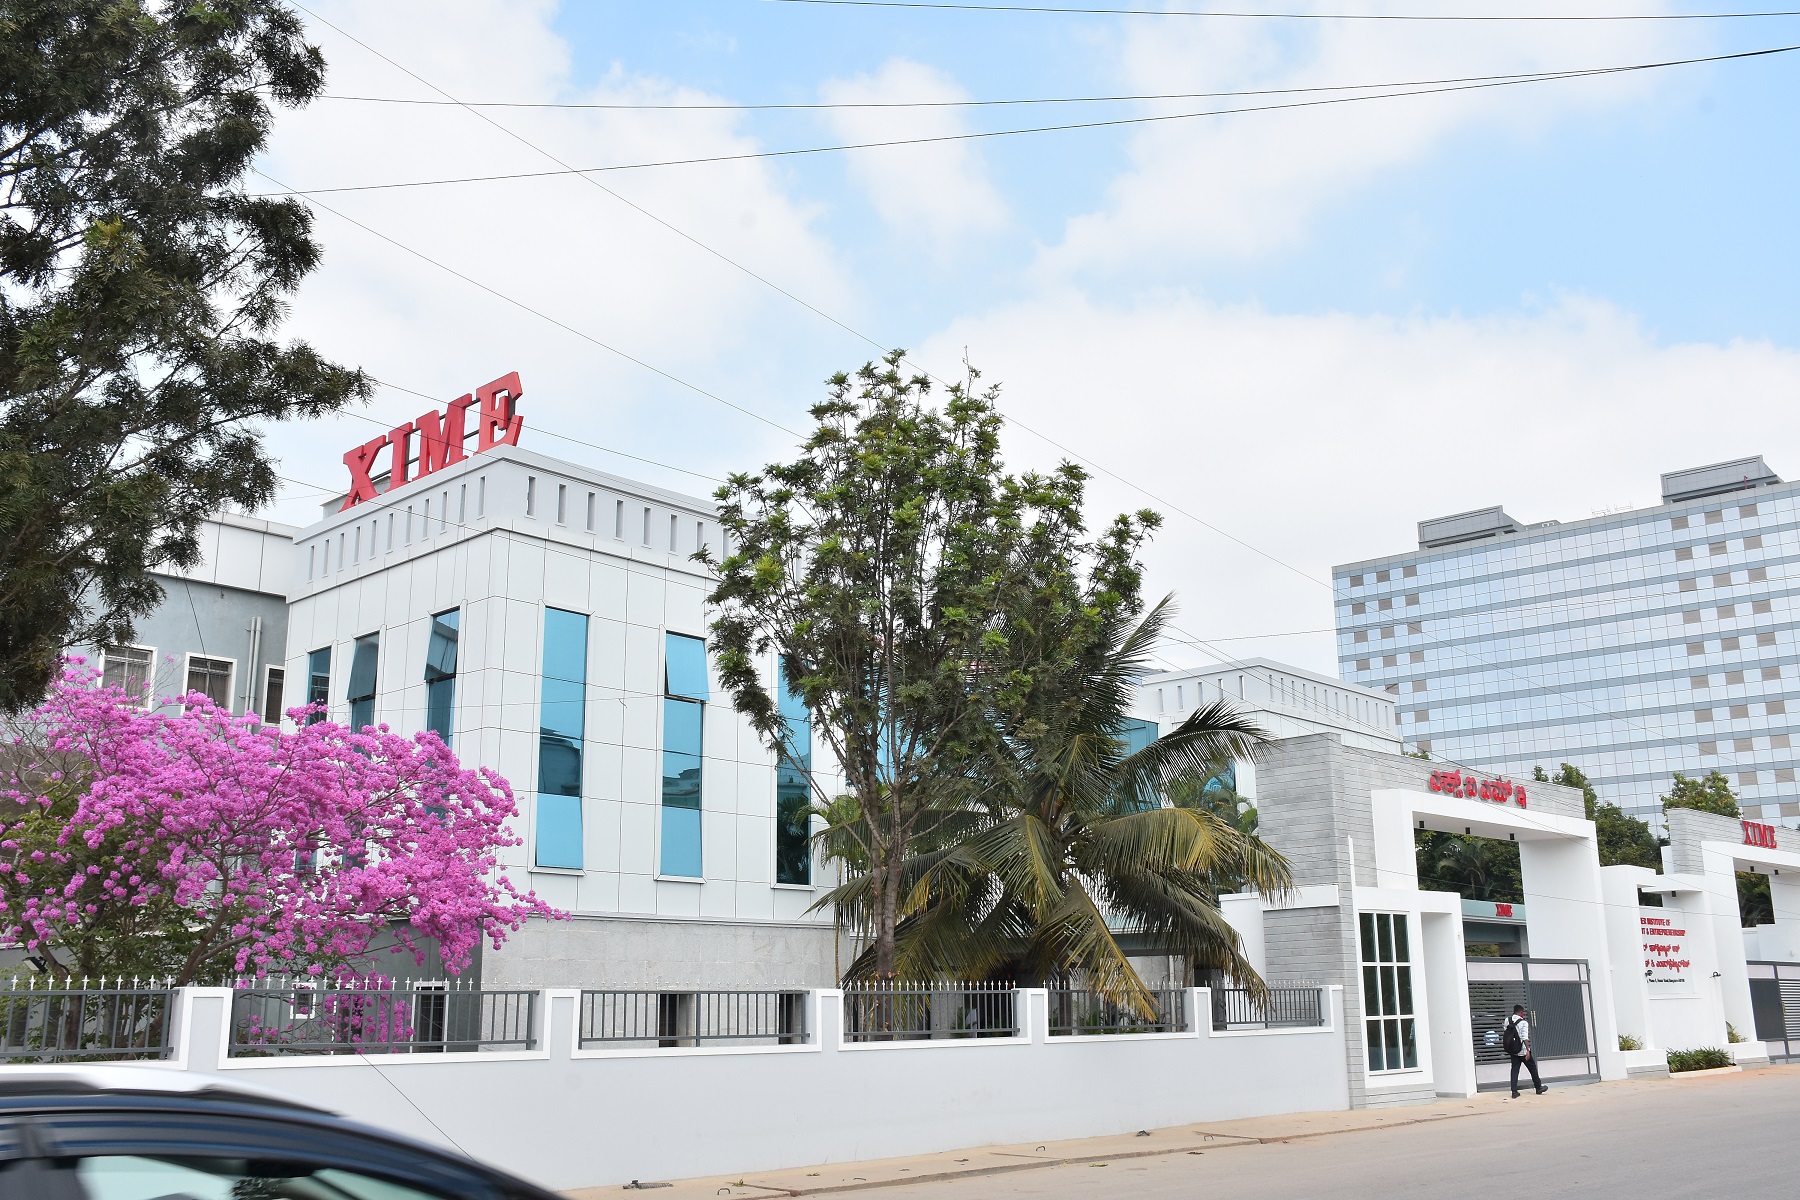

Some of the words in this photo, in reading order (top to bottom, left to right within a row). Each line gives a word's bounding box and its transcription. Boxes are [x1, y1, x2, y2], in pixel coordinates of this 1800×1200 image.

[338, 371, 525, 512] XIME
[1741, 820, 1777, 849] XIME
[1495, 904, 1512, 917] XIME
